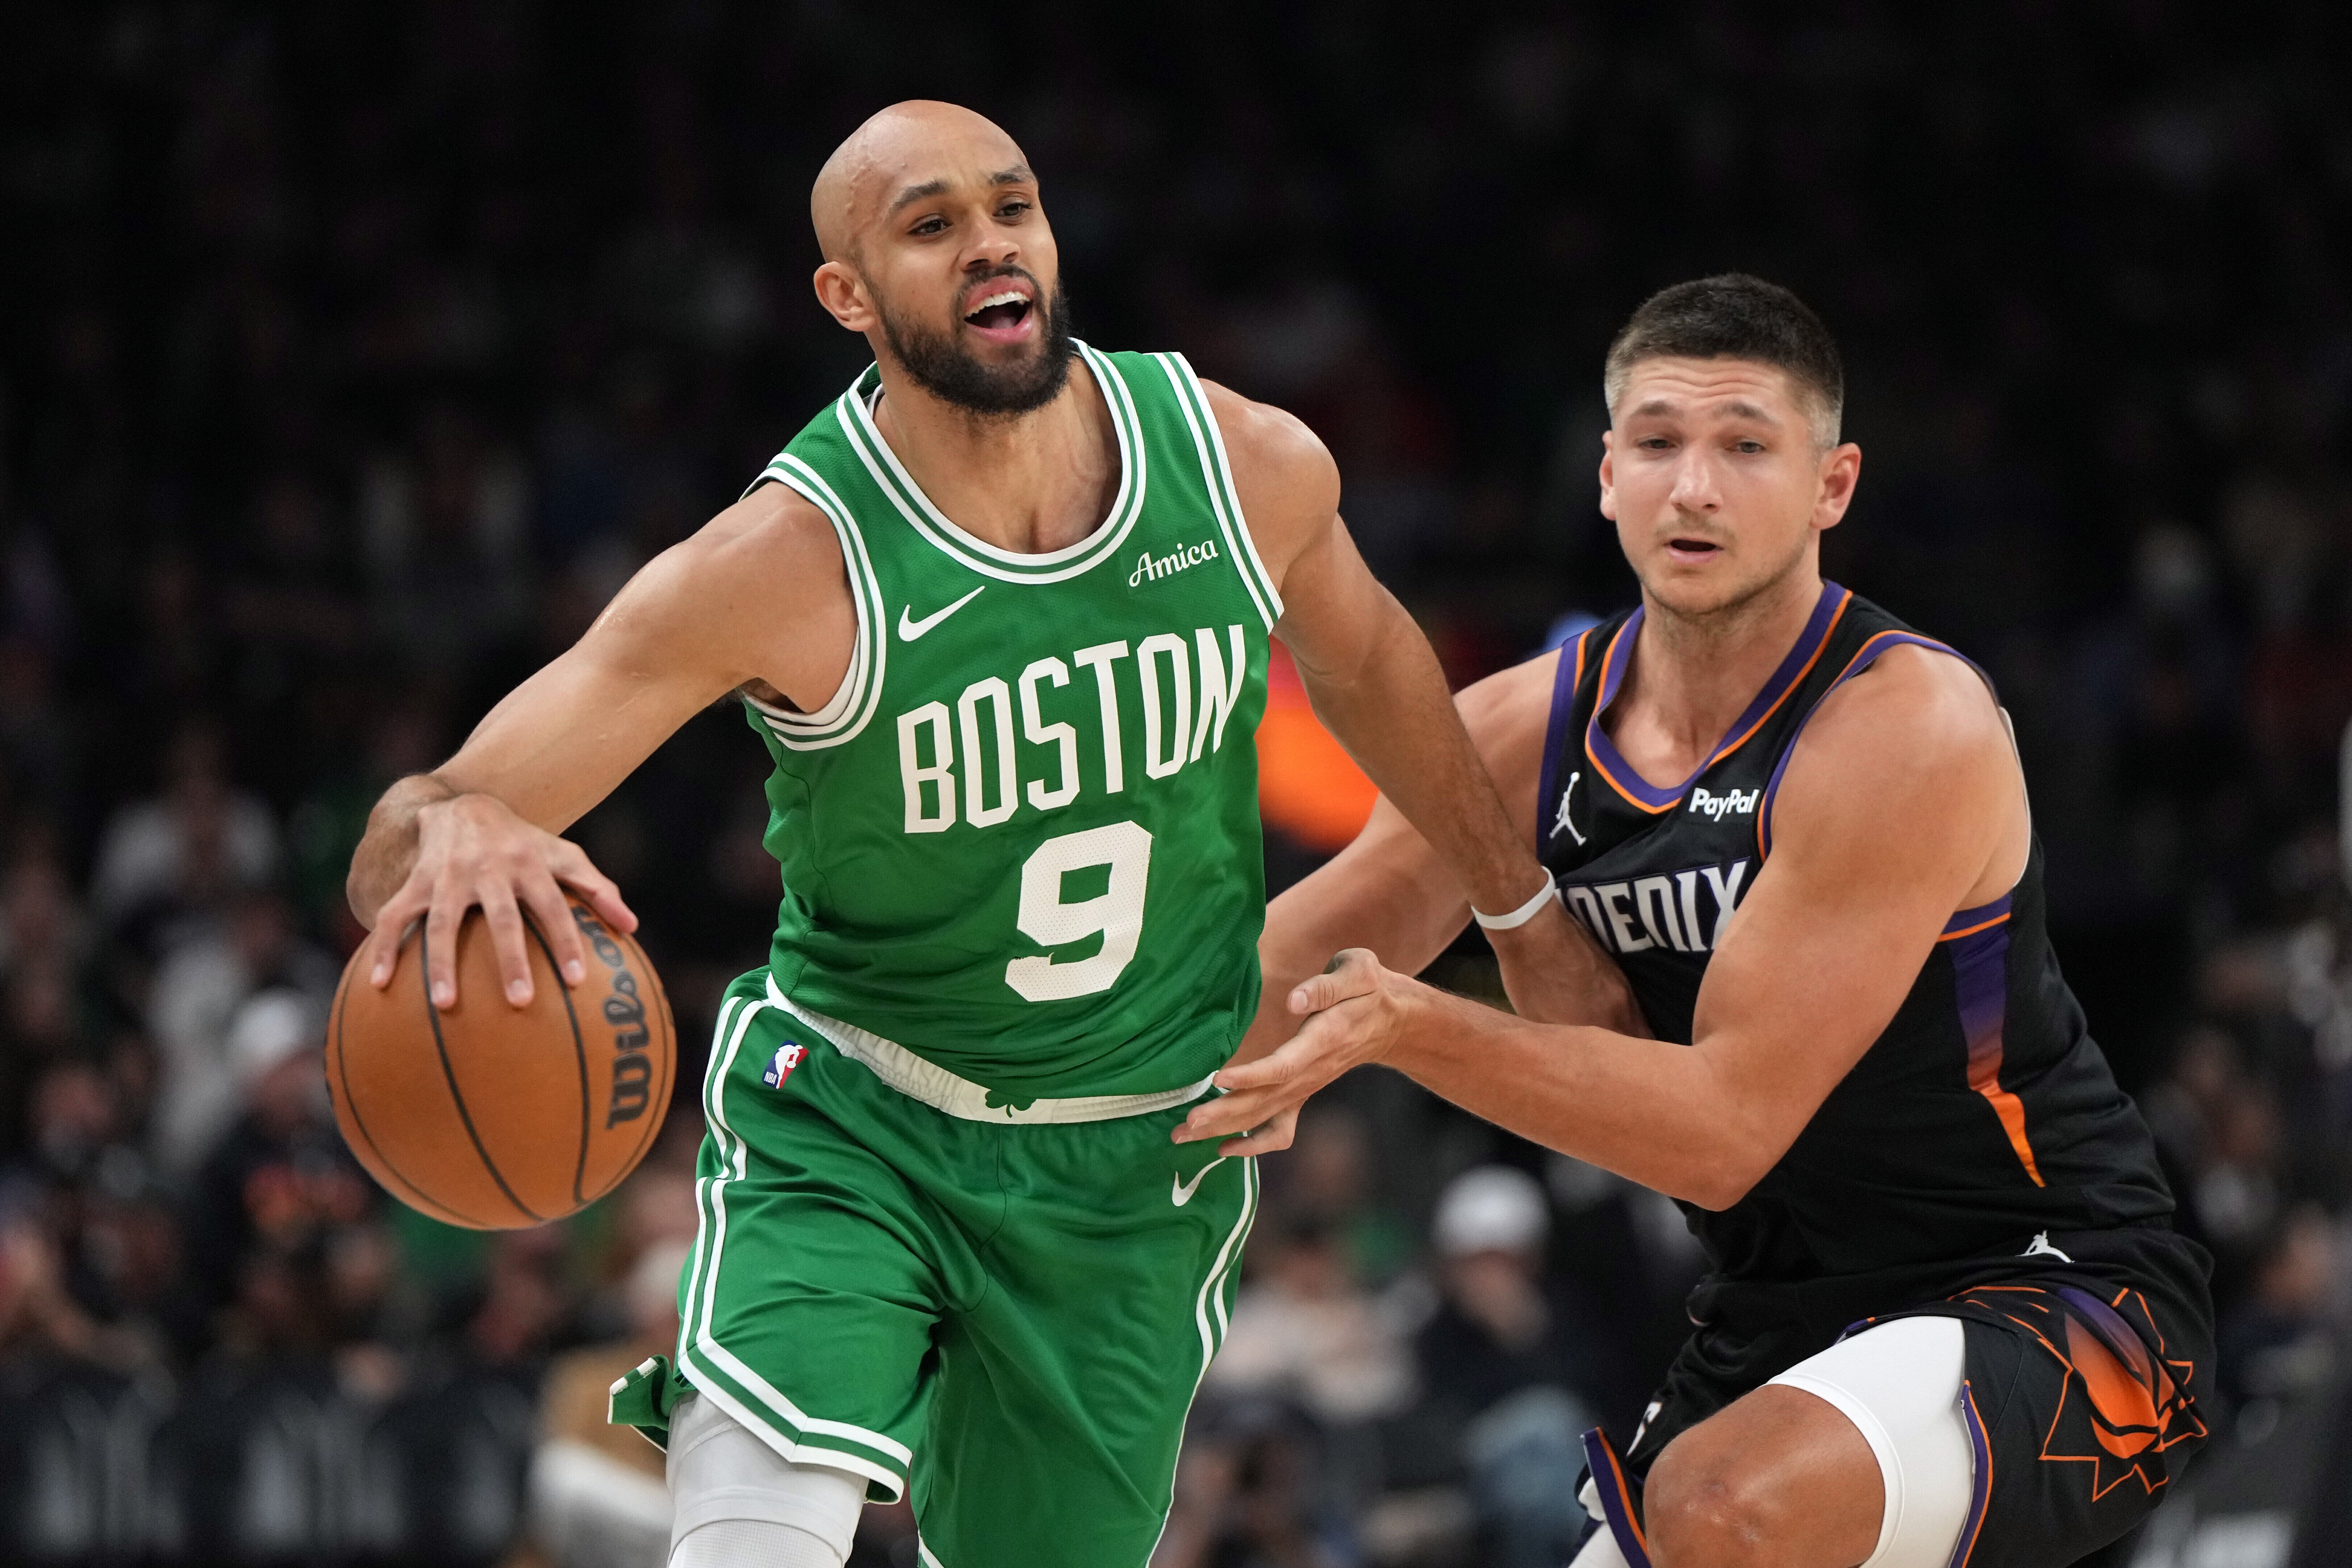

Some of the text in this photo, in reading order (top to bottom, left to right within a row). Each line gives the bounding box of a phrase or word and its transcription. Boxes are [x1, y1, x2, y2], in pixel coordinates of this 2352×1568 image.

[1128, 539, 1219, 587] Amica
[897, 624, 1246, 834] BOSTON
[1688, 787, 1760, 822] PayPal
[1004, 820, 1155, 1002] 9
[1555, 857, 1751, 953] OENIX
[764, 1071, 777, 1084] NBA
